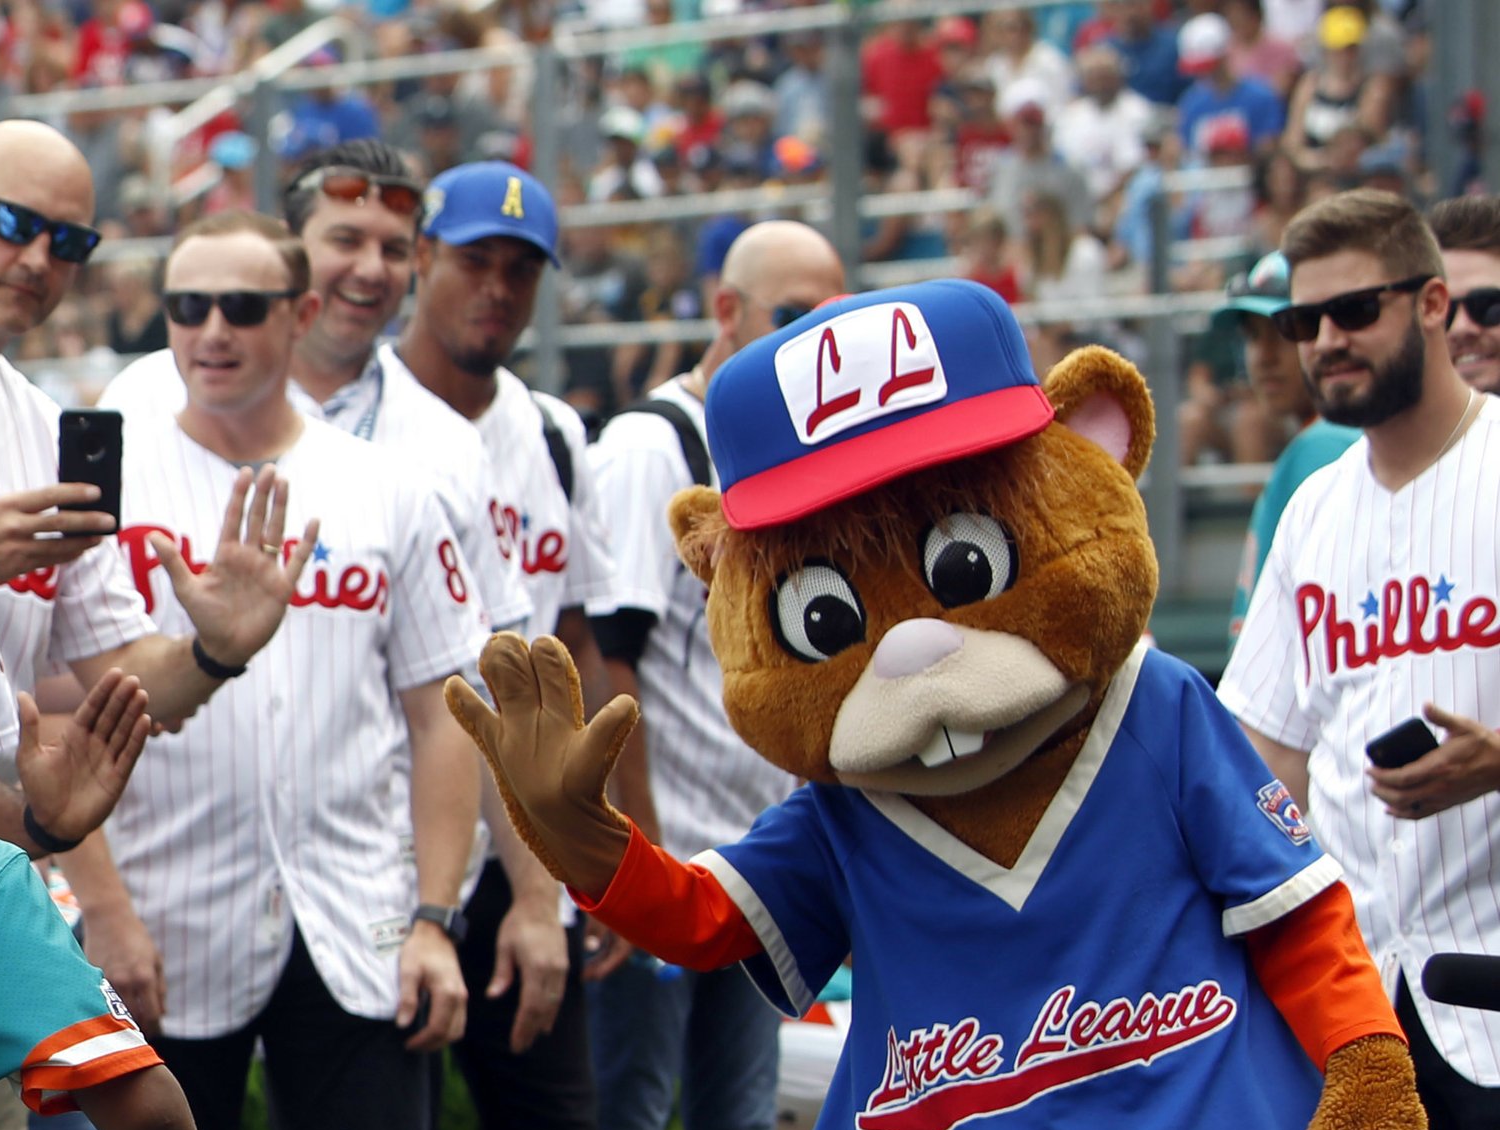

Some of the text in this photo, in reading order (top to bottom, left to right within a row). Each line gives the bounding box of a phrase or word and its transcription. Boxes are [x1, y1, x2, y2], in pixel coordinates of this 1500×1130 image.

[501, 176, 525, 220] A
[438, 538, 468, 603] 8
[867, 980, 1238, 1113] Little League
